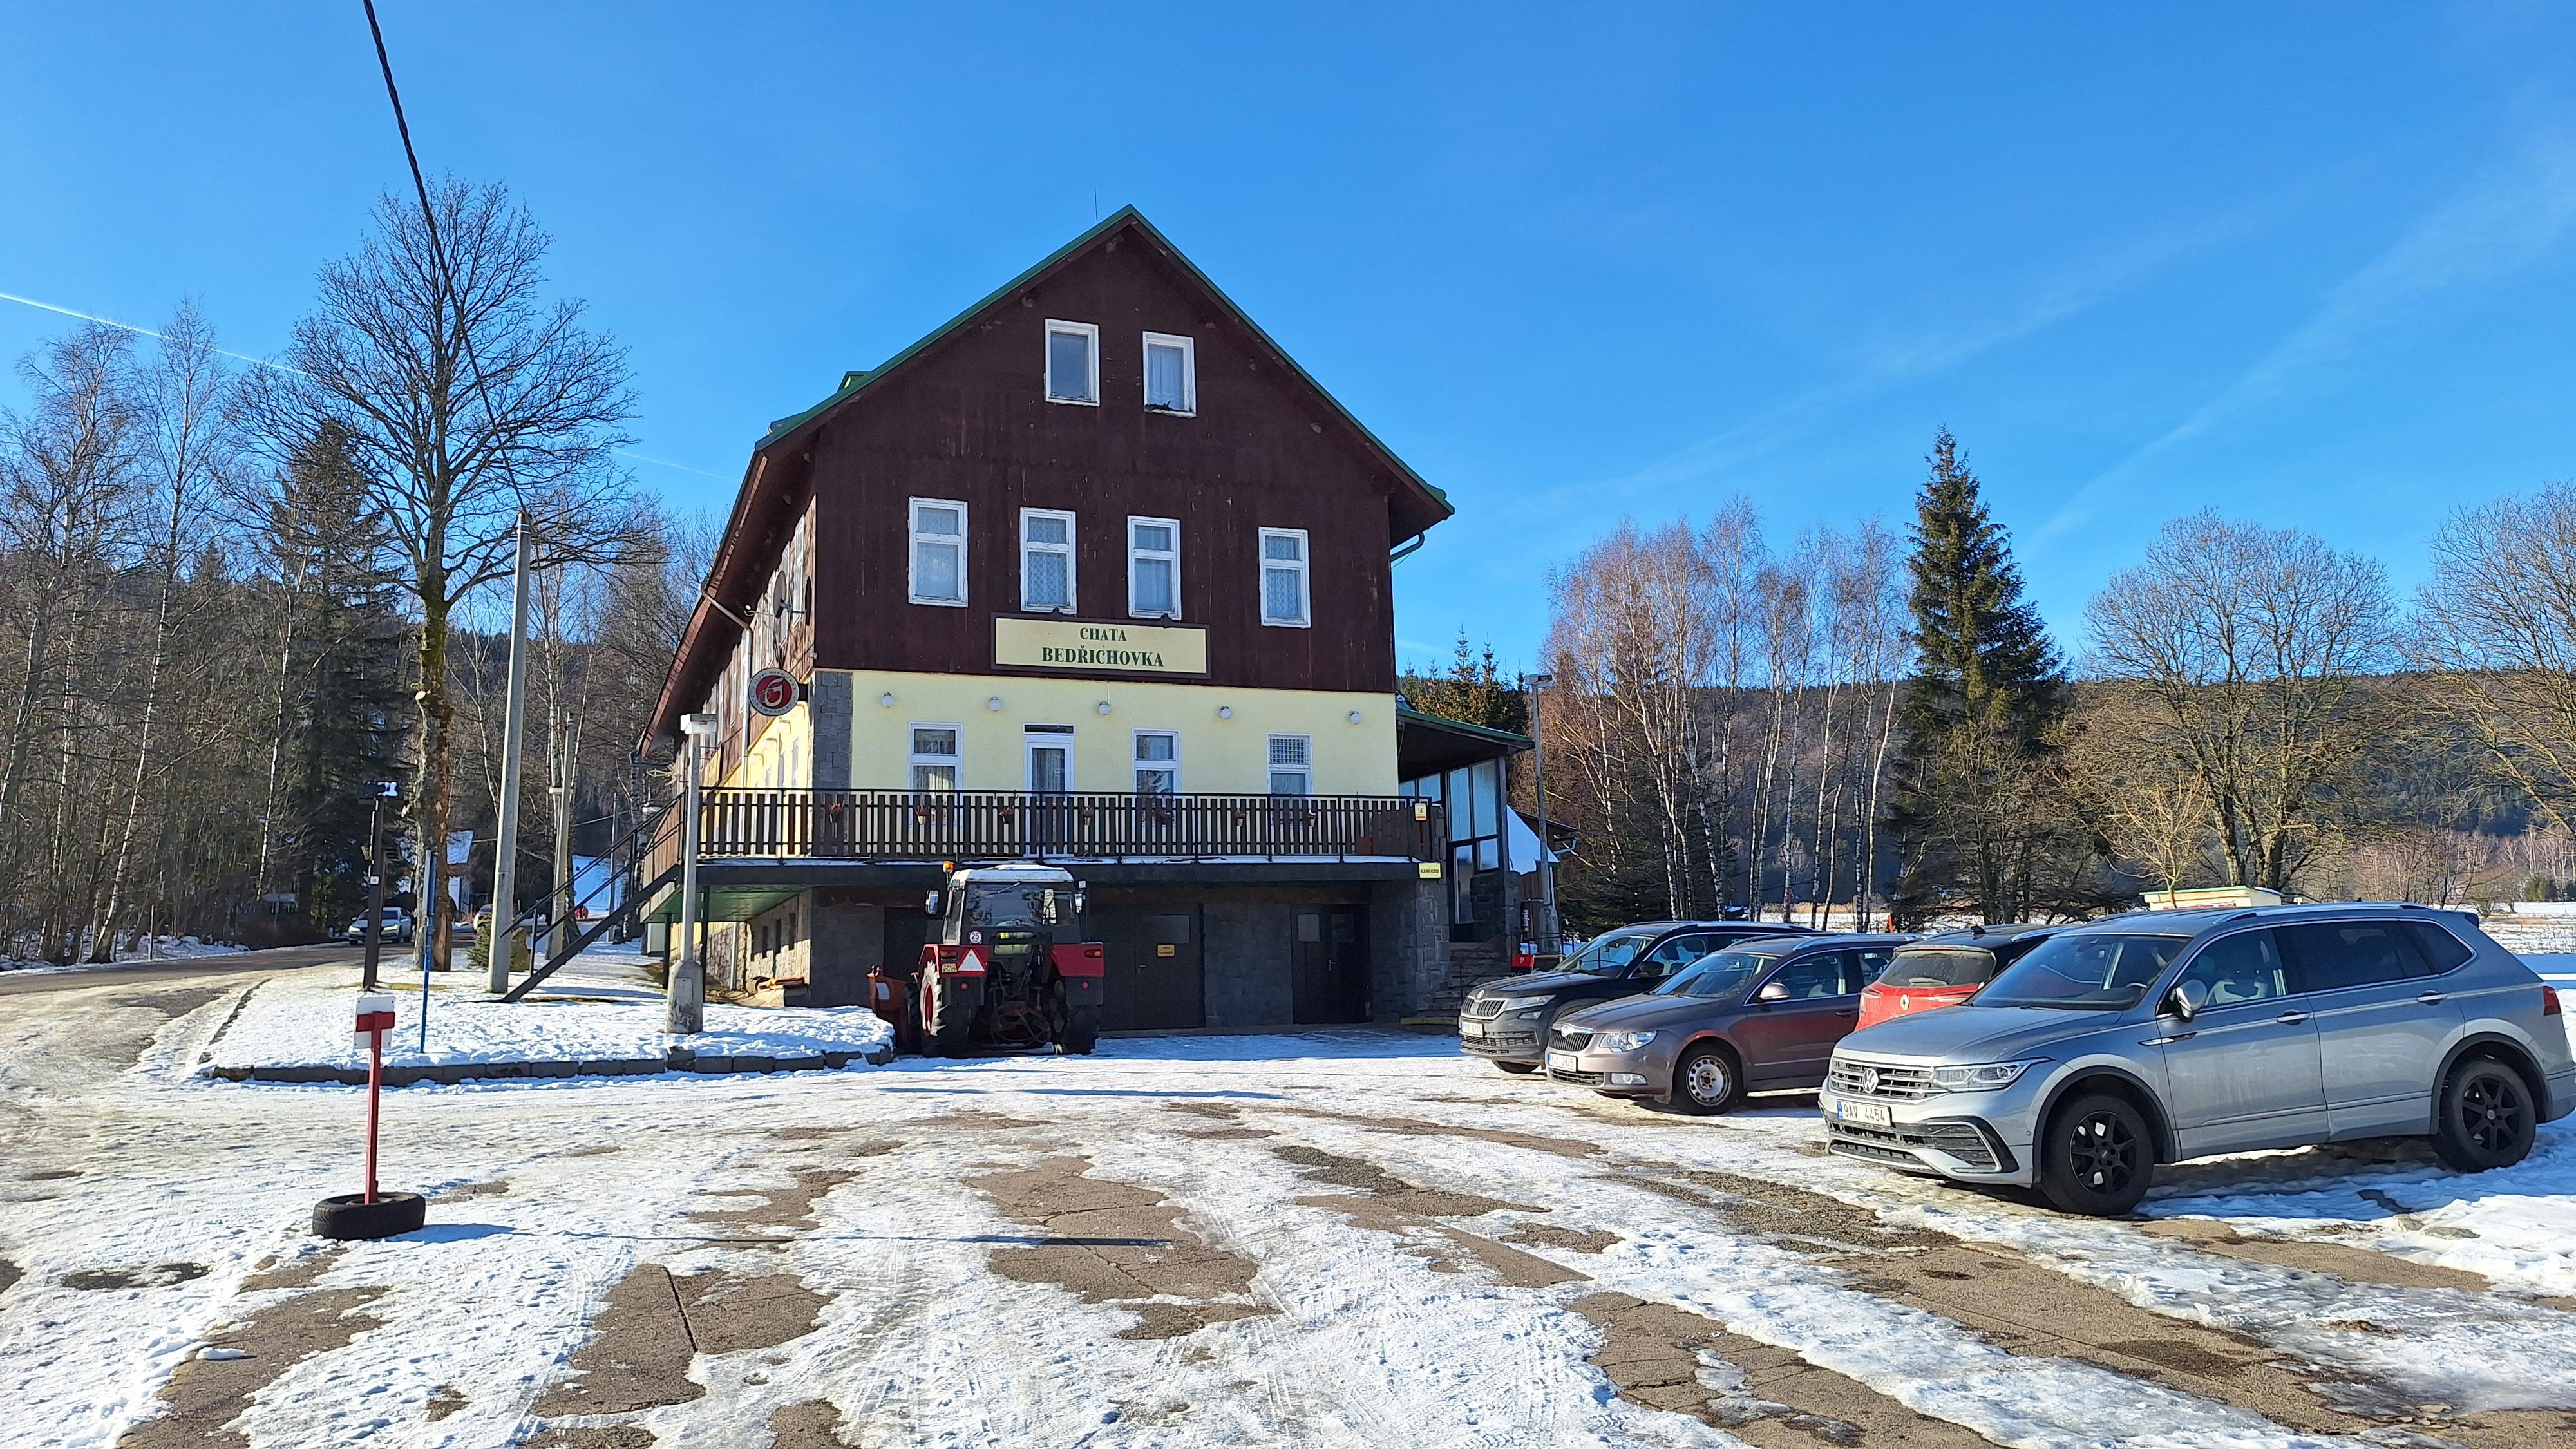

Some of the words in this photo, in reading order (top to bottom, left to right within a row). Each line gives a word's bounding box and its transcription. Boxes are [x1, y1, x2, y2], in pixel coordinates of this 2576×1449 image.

[1079, 627, 1128, 642] CHATA
[1041, 644, 1164, 667] BEDŘICHOVKA
[1844, 1104, 1858, 1119] 9AV
[1865, 1107, 1886, 1123] 4454
